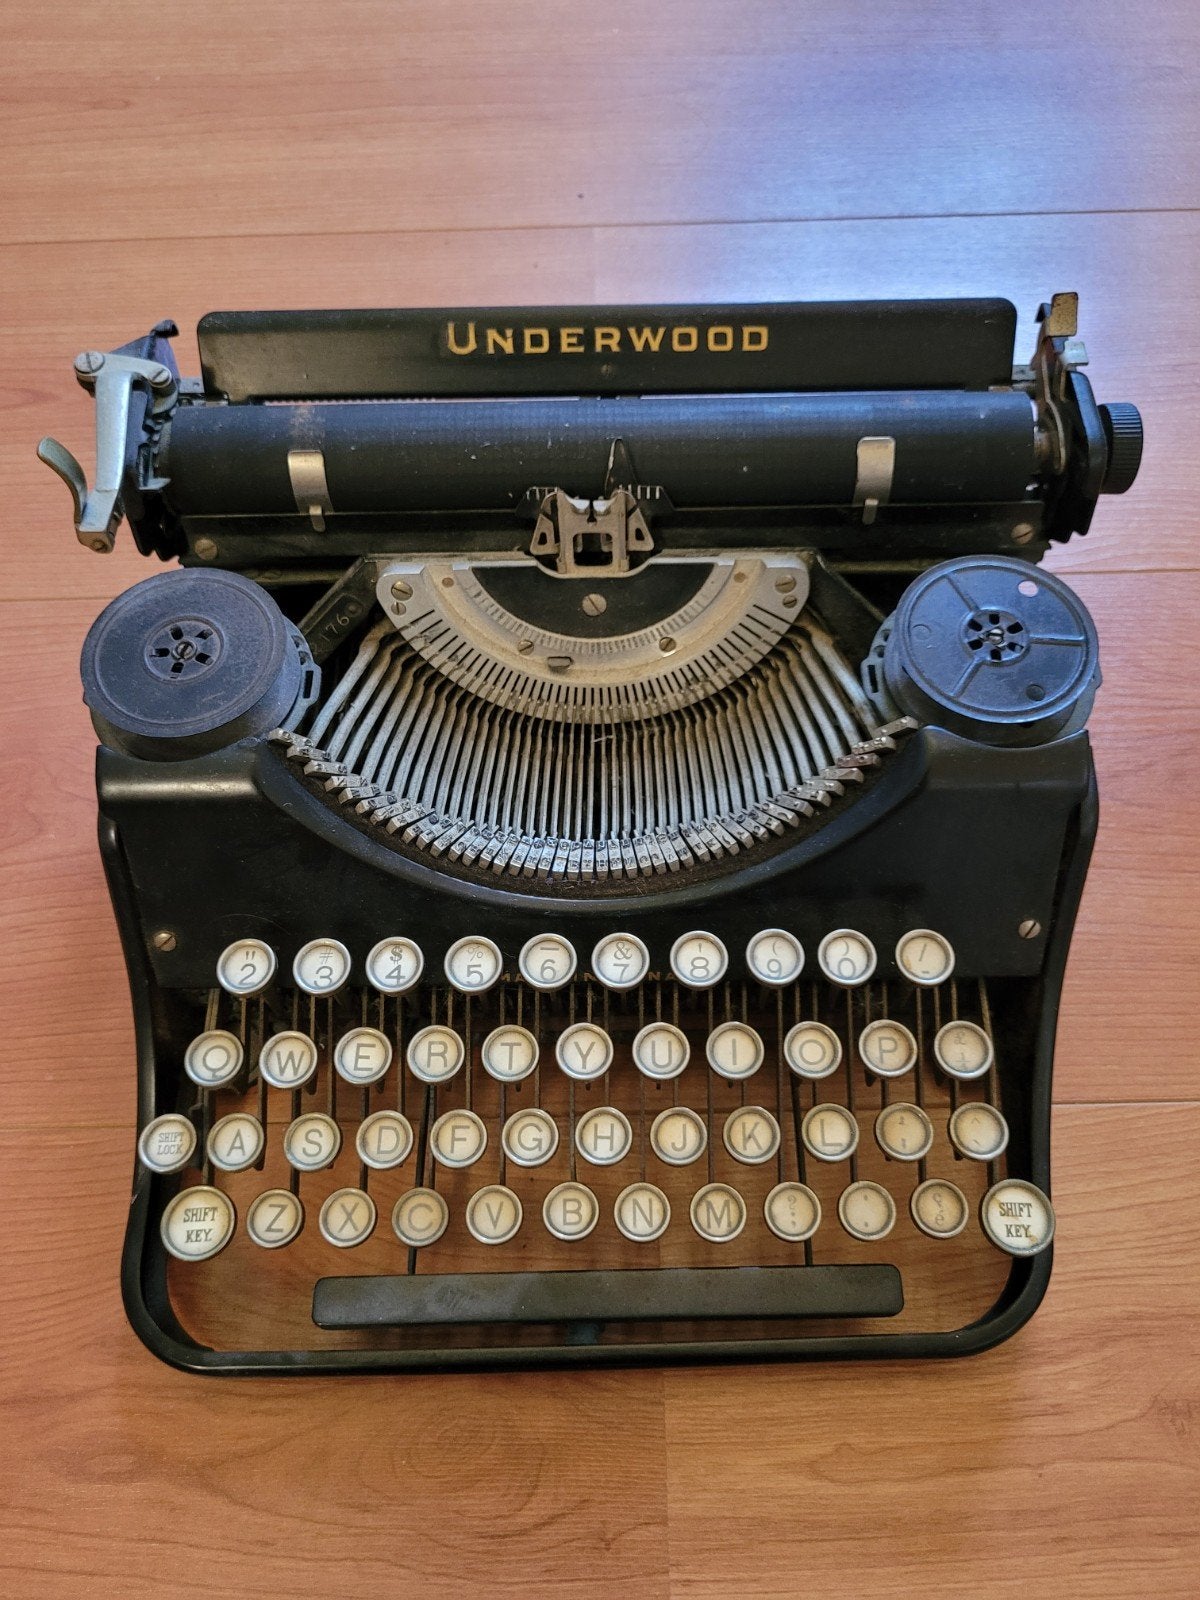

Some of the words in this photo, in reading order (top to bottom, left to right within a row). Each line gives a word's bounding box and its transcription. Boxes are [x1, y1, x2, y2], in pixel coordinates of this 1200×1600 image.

[447, 321, 769, 355] UNDERWOOD
[319, 948, 333, 965] #
[390, 943, 403, 965] $
[467, 945, 483, 962] %
[613, 942, 632, 960] &
[238, 963, 257, 985] 2
[313, 965, 334, 987] 3
[385, 963, 406, 987] 4
[466, 964, 484, 986] 5
[540, 958, 556, 981] 6
[613, 963, 630, 982] 7
[690, 956, 709, 979] 8
[767, 958, 782, 979] 9
[203, 1045, 231, 1079] Q
[276, 1050, 305, 1077] W
[353, 1043, 377, 1072] E
[426, 1040, 449, 1069] R
[501, 1042, 522, 1071] T
[574, 1041, 597, 1070] Y
[651, 1040, 672, 1069] U
[799, 1039, 827, 1066] O
[878, 1036, 899, 1064] P
[158, 1131, 185, 1143] SHIFT
[226, 1128, 246, 1157] A
[302, 1128, 323, 1158] S
[376, 1125, 401, 1155] D
[450, 1125, 471, 1154] F
[517, 1122, 543, 1153] G
[593, 1122, 615, 1152] H
[671, 1123, 687, 1152] J
[741, 1121, 763, 1152] K
[819, 1118, 844, 1147] L
[157, 1144, 183, 1156] LOCK
[183, 1206, 218, 1224] SHIFT
[265, 1203, 289, 1233] Z
[337, 1201, 360, 1233] X
[408, 1202, 433, 1232] C
[485, 1200, 504, 1230] V
[562, 1198, 583, 1226] B
[632, 1197, 654, 1229] N
[706, 1199, 732, 1230] M
[999, 1202, 1033, 1218] SHIFT
